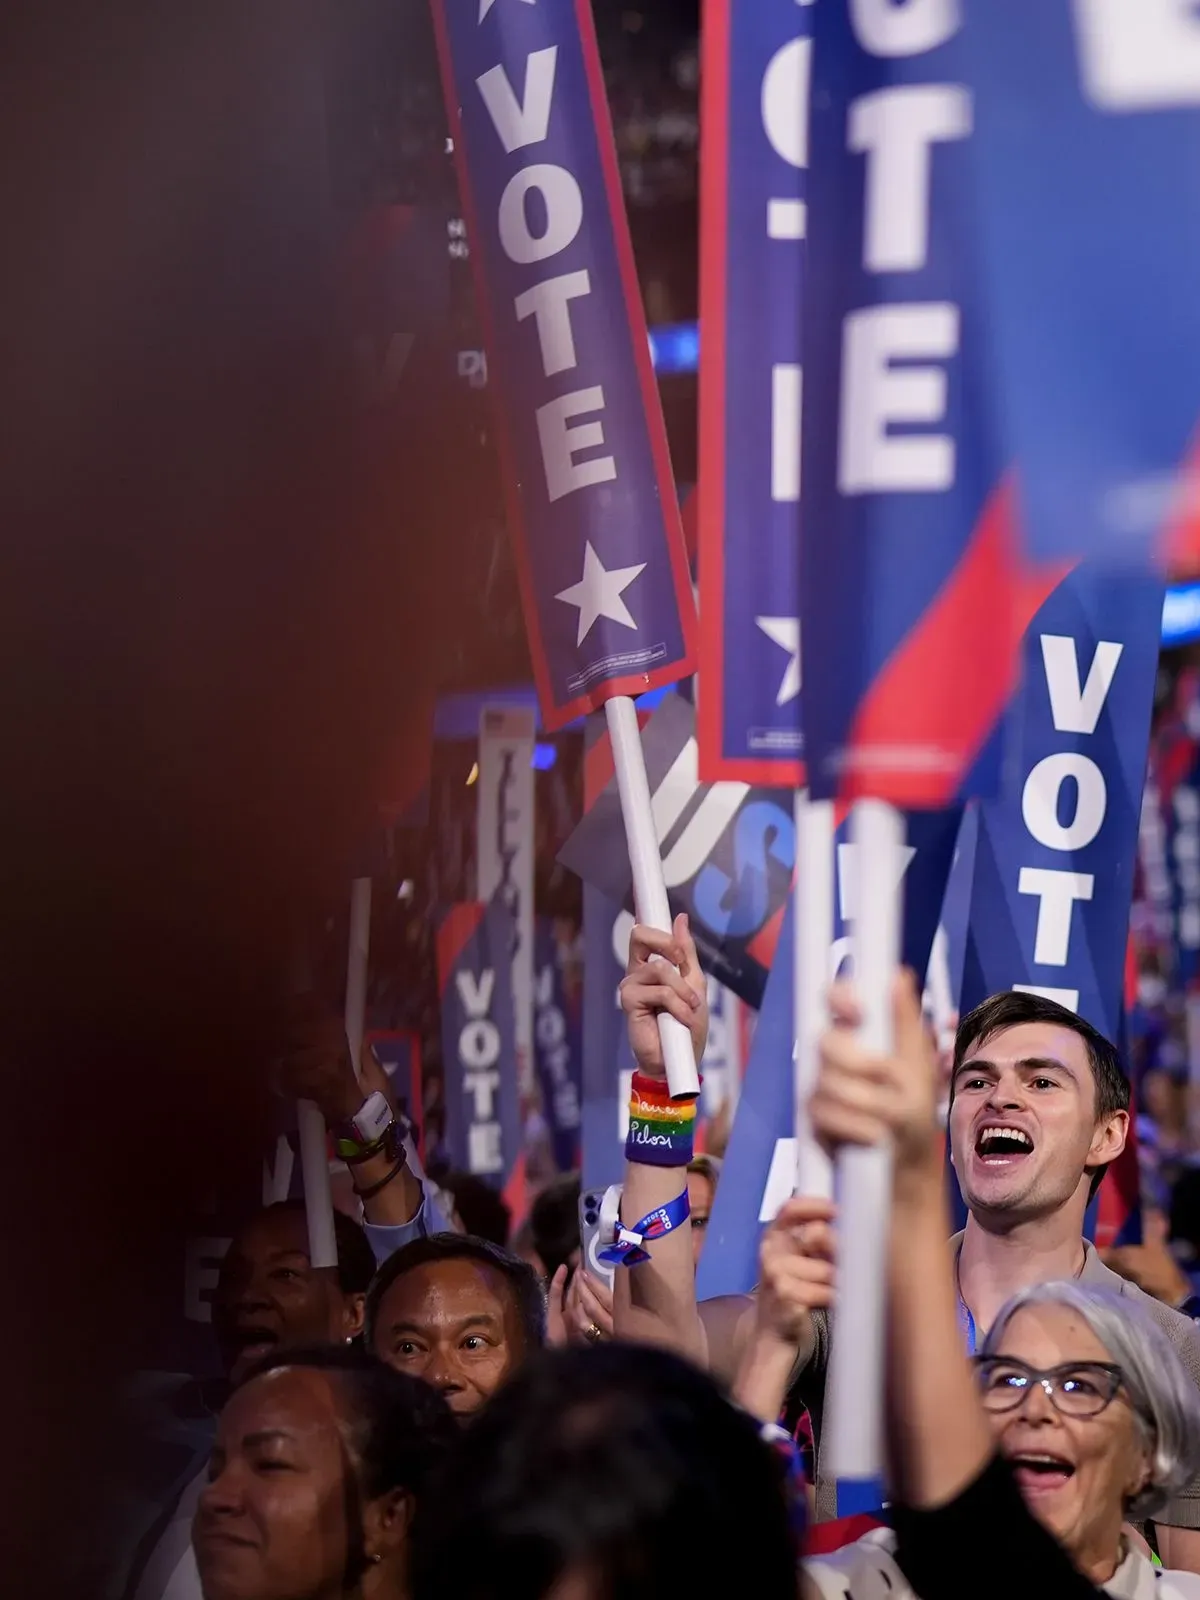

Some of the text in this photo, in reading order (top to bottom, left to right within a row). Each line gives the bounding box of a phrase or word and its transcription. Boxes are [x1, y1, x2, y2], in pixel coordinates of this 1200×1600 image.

[475, 45, 617, 503] VOTE
[1011, 634, 1123, 1012] VOT
[456, 969, 504, 1175] VOTE
[630, 1121, 675, 1149] Pelosi
